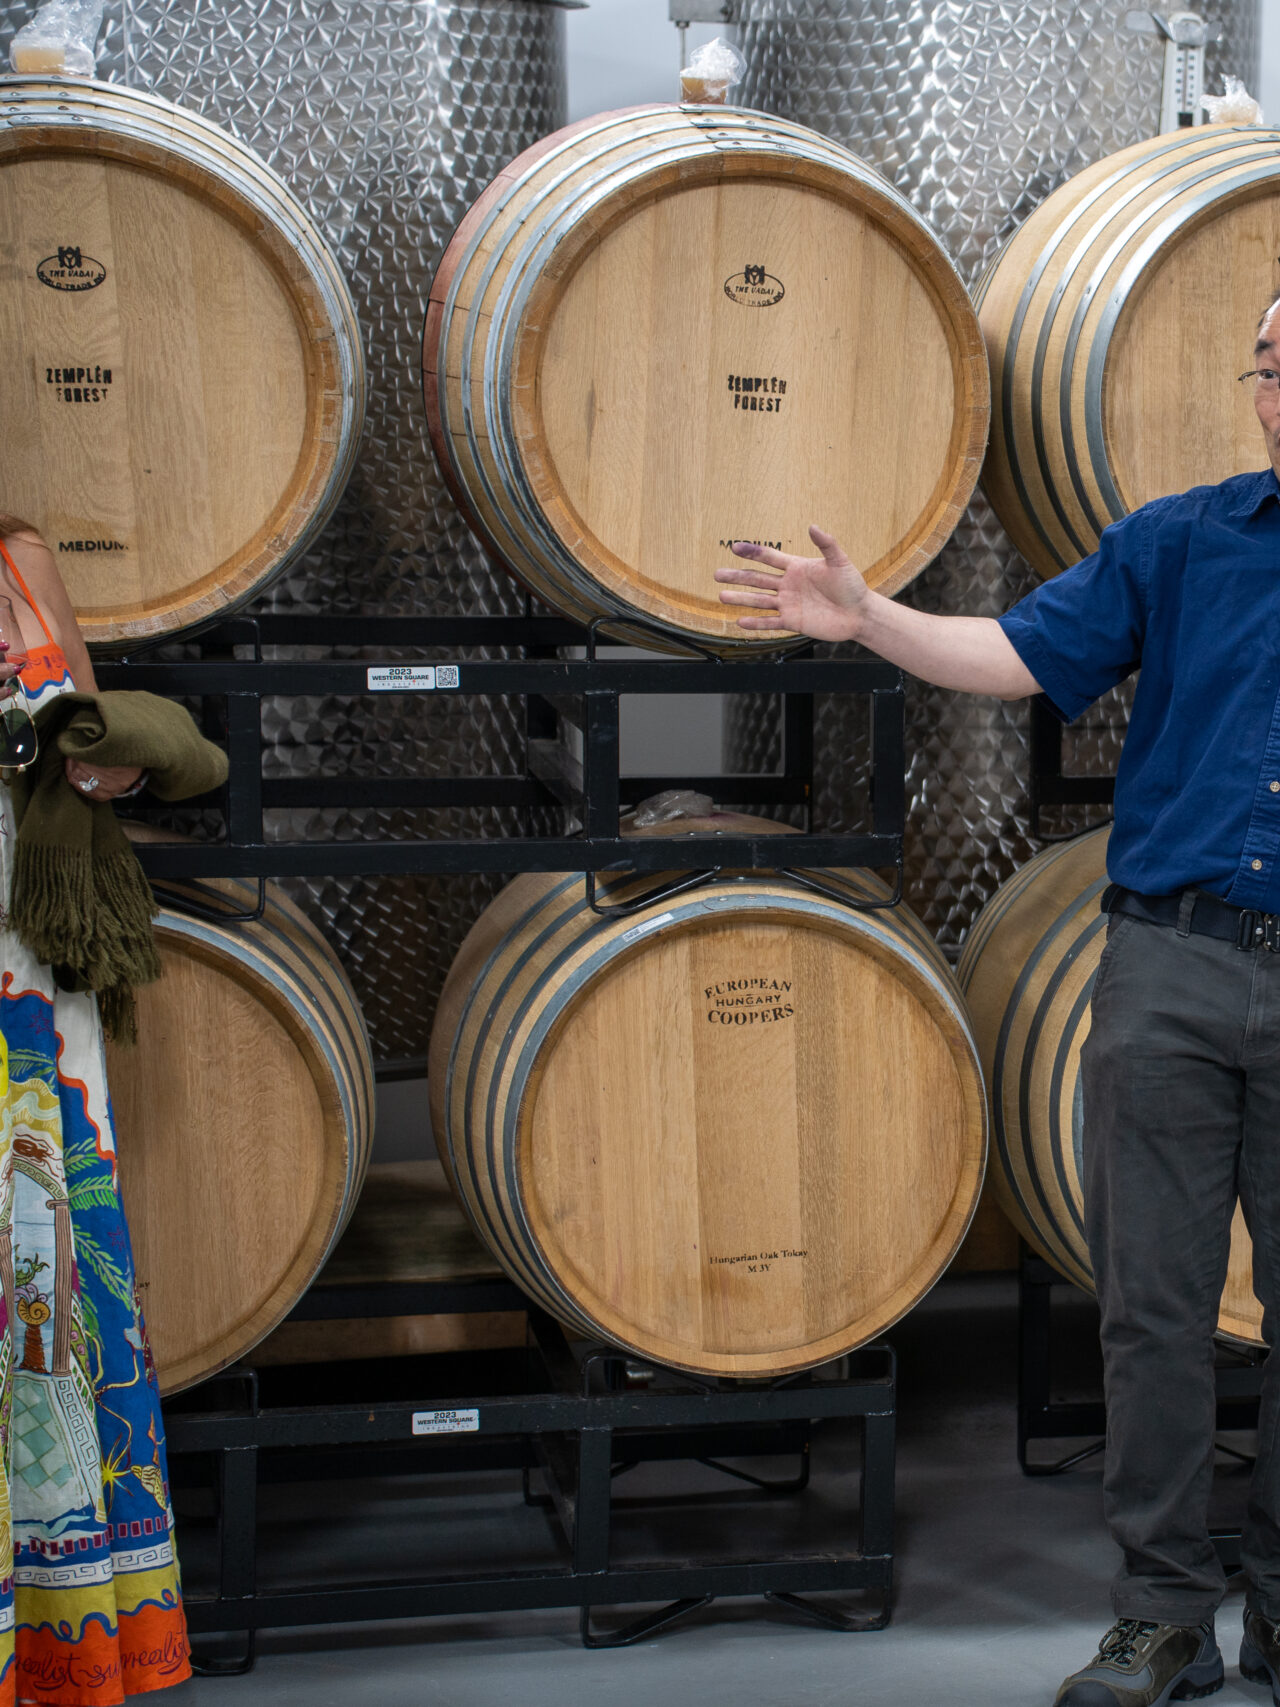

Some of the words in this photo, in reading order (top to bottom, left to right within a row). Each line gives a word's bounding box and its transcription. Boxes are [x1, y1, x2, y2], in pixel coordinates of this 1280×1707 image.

[46, 365, 113, 384] ZEMPLÉN
[734, 393, 782, 412] FOREST
[704, 978, 792, 999] EUROPEAN
[716, 995, 781, 1007] HUNGARY
[707, 1003, 795, 1025] COOPERS
[709, 1253, 758, 1265] Hungarian
[759, 1250, 779, 1260] Oak
[780, 1248, 808, 1259] Tokay
[747, 1264, 758, 1274] M
[759, 1263, 771, 1273] 3Y
[434, 1411, 457, 1419] 2023
